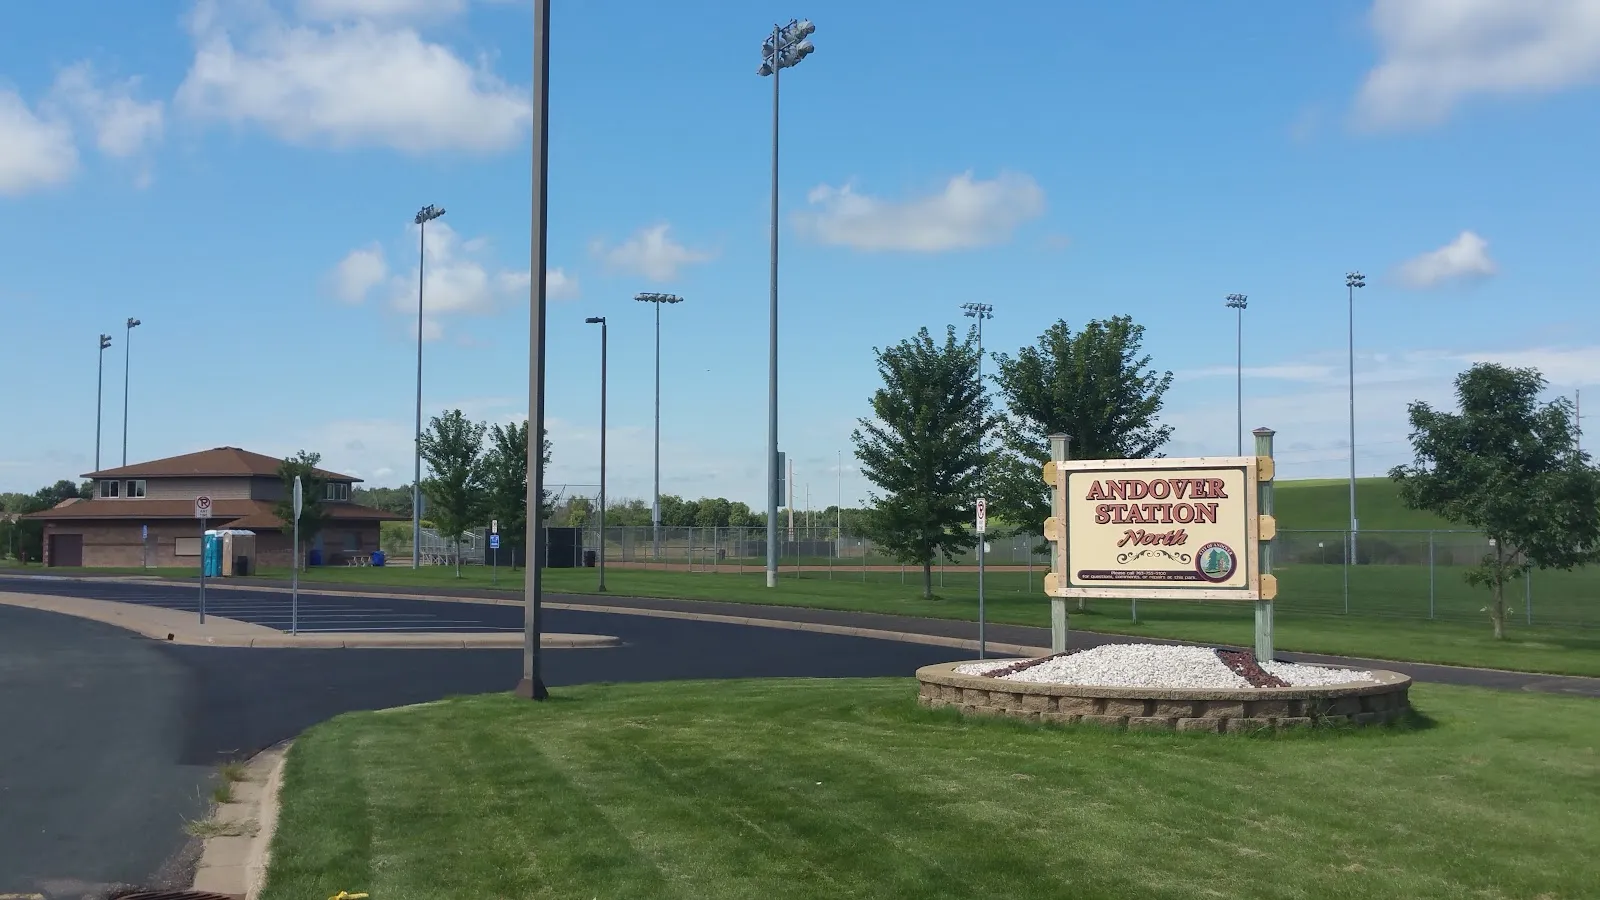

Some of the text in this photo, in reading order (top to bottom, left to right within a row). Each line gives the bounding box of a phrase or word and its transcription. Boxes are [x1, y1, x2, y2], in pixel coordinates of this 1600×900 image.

[1086, 478, 1228, 500] ANDOVER
[1095, 502, 1219, 524] STATION
[1117, 528, 1189, 547] North
